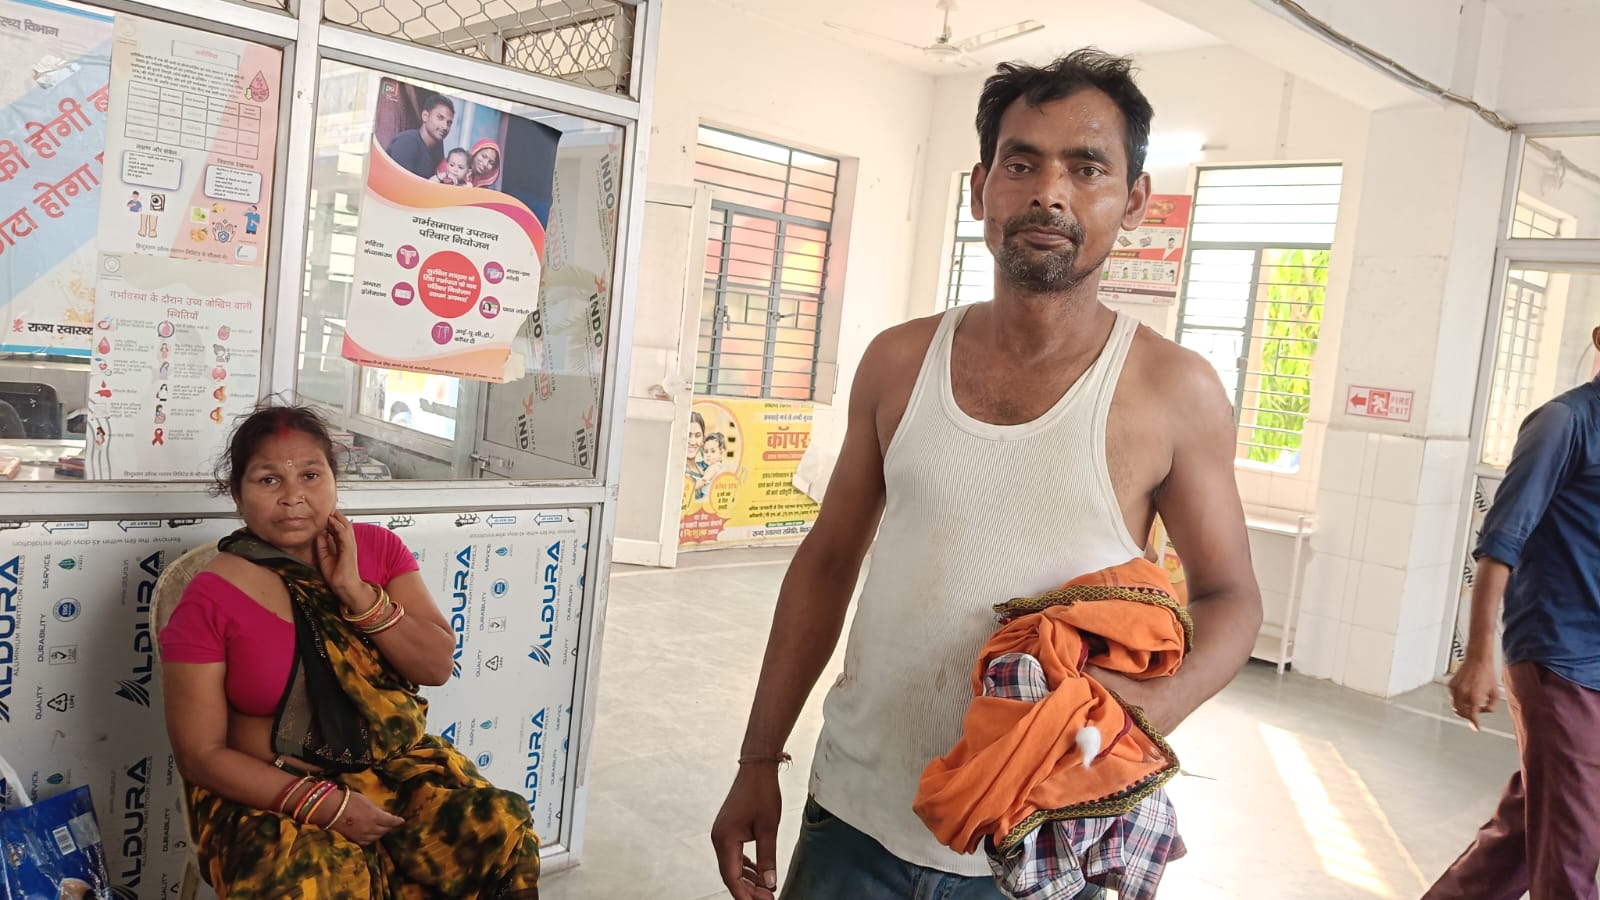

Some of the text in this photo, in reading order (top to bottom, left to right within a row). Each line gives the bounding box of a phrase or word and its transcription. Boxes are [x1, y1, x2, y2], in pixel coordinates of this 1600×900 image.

[24, 18, 59, 37] विभाग
[24, 97, 93, 158] होगी
[33, 162, 100, 218] होगा
[412, 215, 498, 242] गर्भसमापन उपरान्त
[419, 229, 489, 250] परिवार नियोजन
[150, 292, 158, 301] के
[162, 293, 182, 304] दौरान
[186, 298, 202, 306] उच्च
[28, 322, 54, 334] राज्य
[766, 426, 810, 448] कॉपर
[38, 614, 46, 662] DURABILITY
[42, 554, 50, 589] SERVICE
[528, 540, 560, 668] ALDURA
